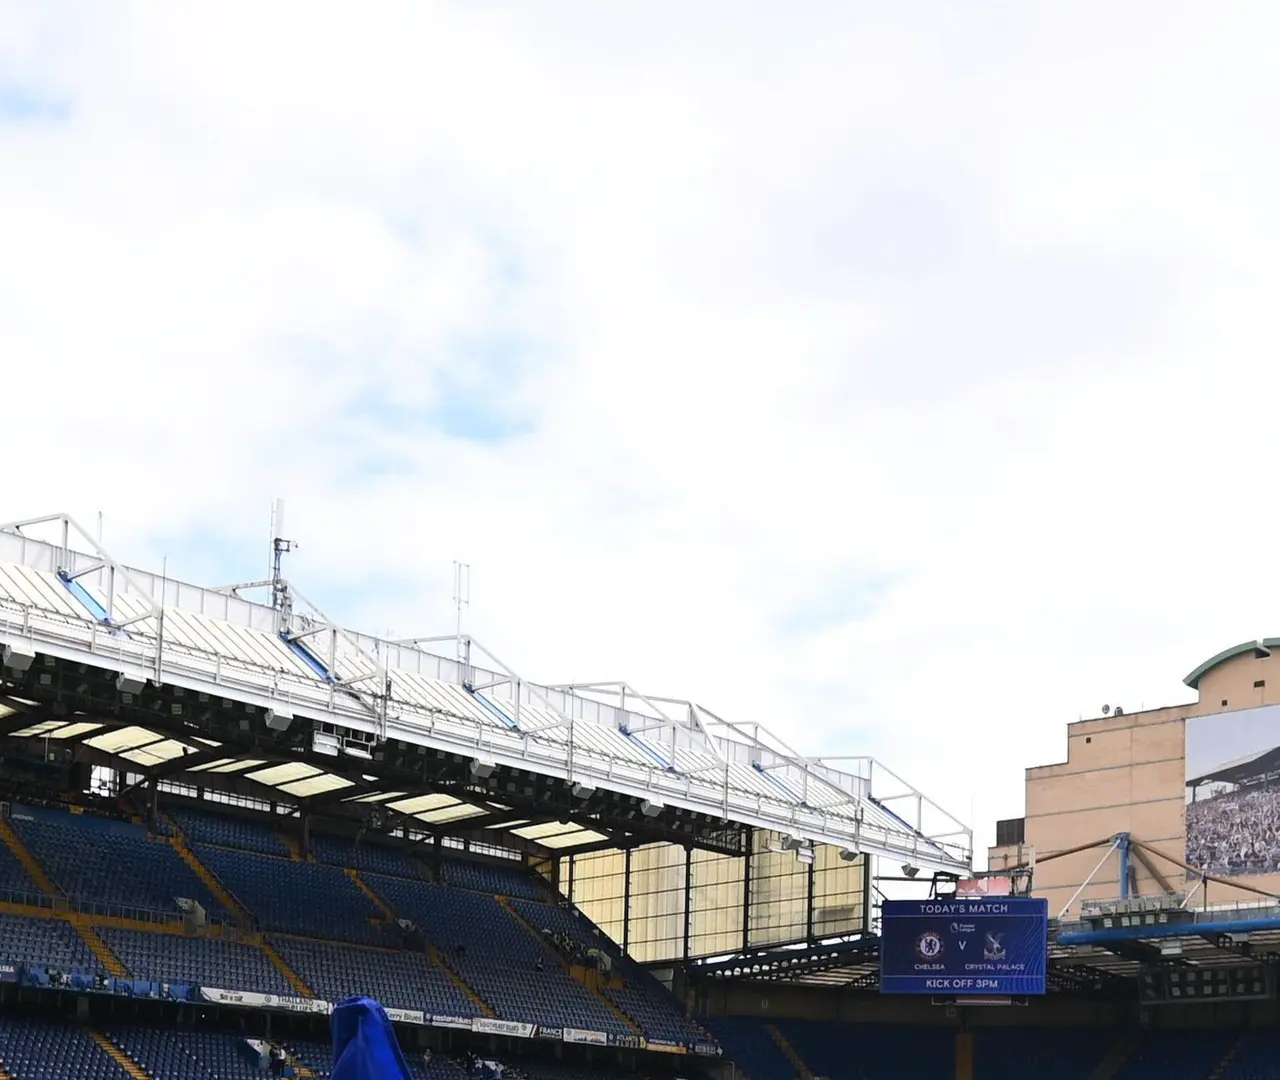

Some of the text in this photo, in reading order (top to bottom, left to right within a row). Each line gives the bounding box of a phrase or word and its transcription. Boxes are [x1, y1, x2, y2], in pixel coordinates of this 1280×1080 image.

[920, 904, 1009, 914] TODAY'S MATCH
[914, 963, 946, 971] CHELSEA
[964, 963, 1025, 971] CRYSTAL PALACE
[926, 979, 999, 989] KICK OFF 3PM
[540, 1027, 563, 1035] FRANCE
